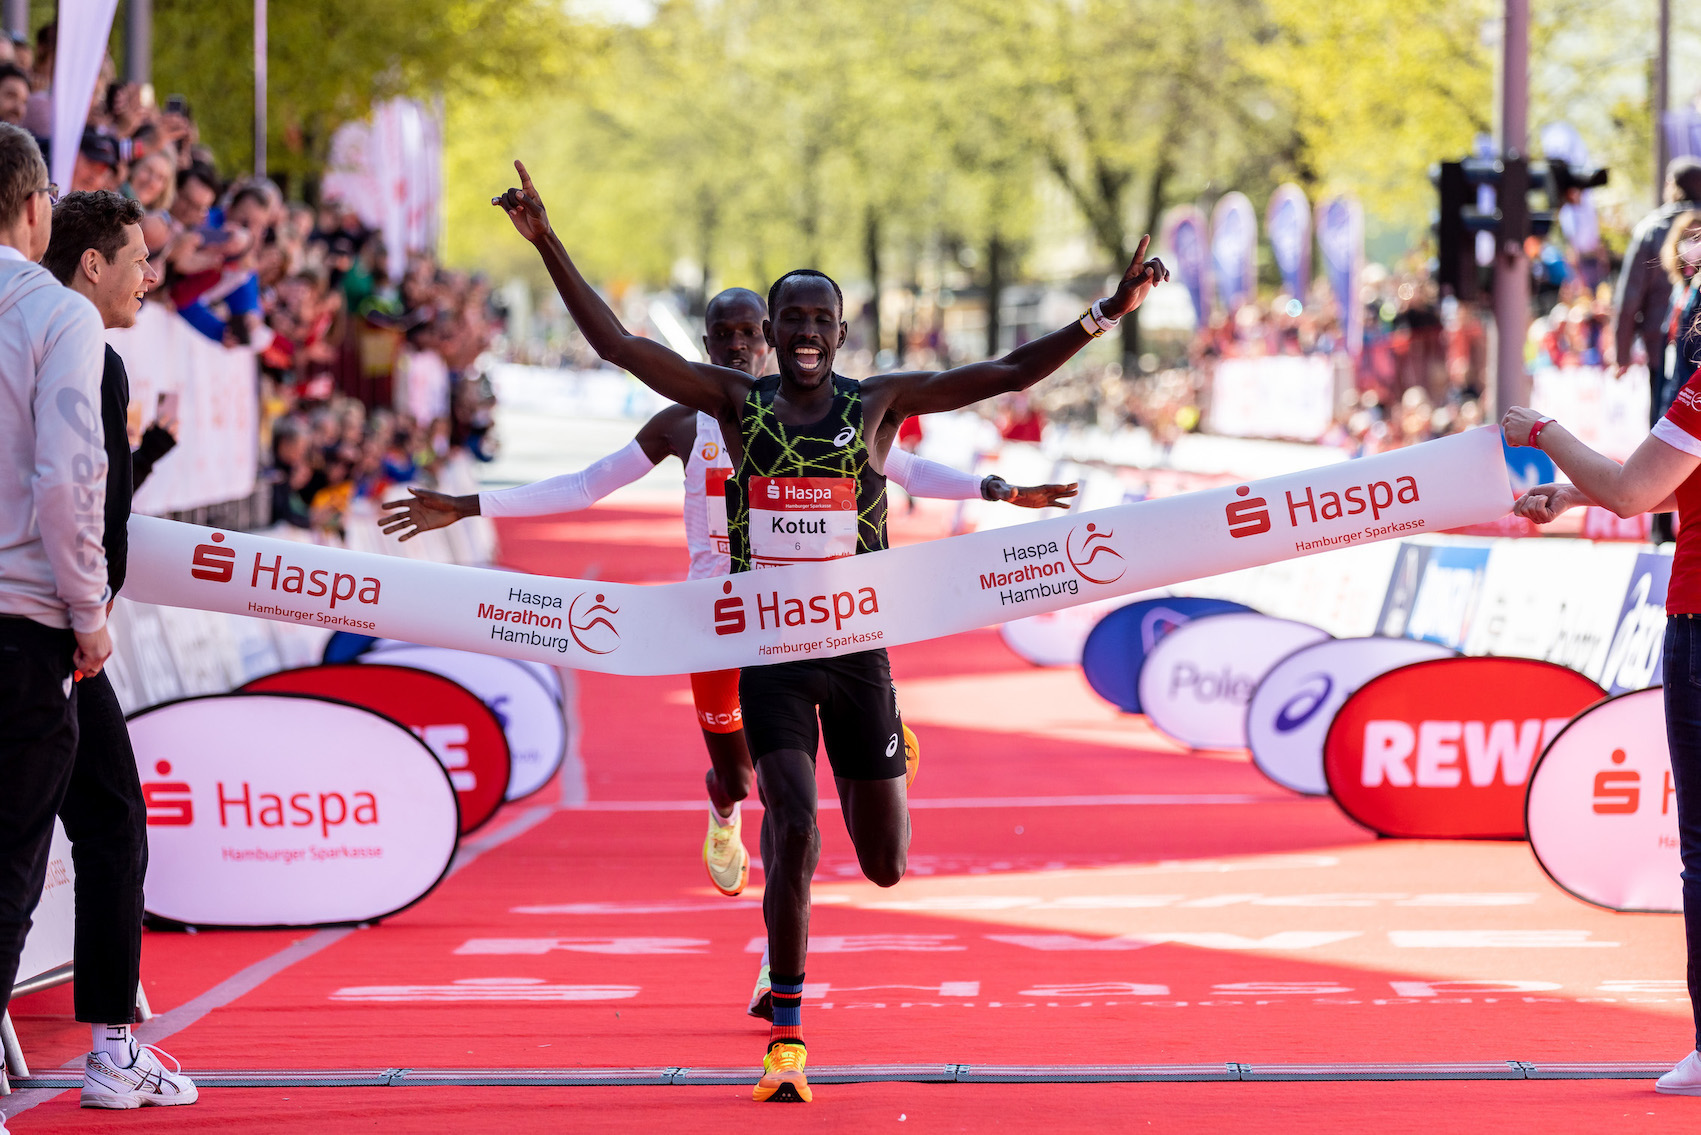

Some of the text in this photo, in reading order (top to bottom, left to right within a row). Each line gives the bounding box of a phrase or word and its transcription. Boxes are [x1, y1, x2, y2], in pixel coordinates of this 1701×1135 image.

[785, 486, 832, 503] Haspa
[1285, 475, 1421, 528] Haspa
[772, 516, 827, 534] Kotut
[1295, 516, 1426, 553] Hamburger Sparkasse
[794, 542, 801, 551] 6
[1003, 541, 1059, 563] Haspa
[250, 552, 381, 608] Haspa
[980, 560, 1066, 591] Marathon
[509, 588, 562, 609] Haspa
[999, 577, 1079, 606] Hamburg
[247, 601, 376, 631] Hamburger Sparkasse
[478, 603, 562, 629] Marathon
[757, 586, 880, 630] Haspa
[491, 624, 569, 653] Hamburg
[758, 630, 884, 656] Hamburger Sparkasse
[216, 781, 379, 839] Haspa
[222, 845, 384, 866] Hamburger Sparkasse
